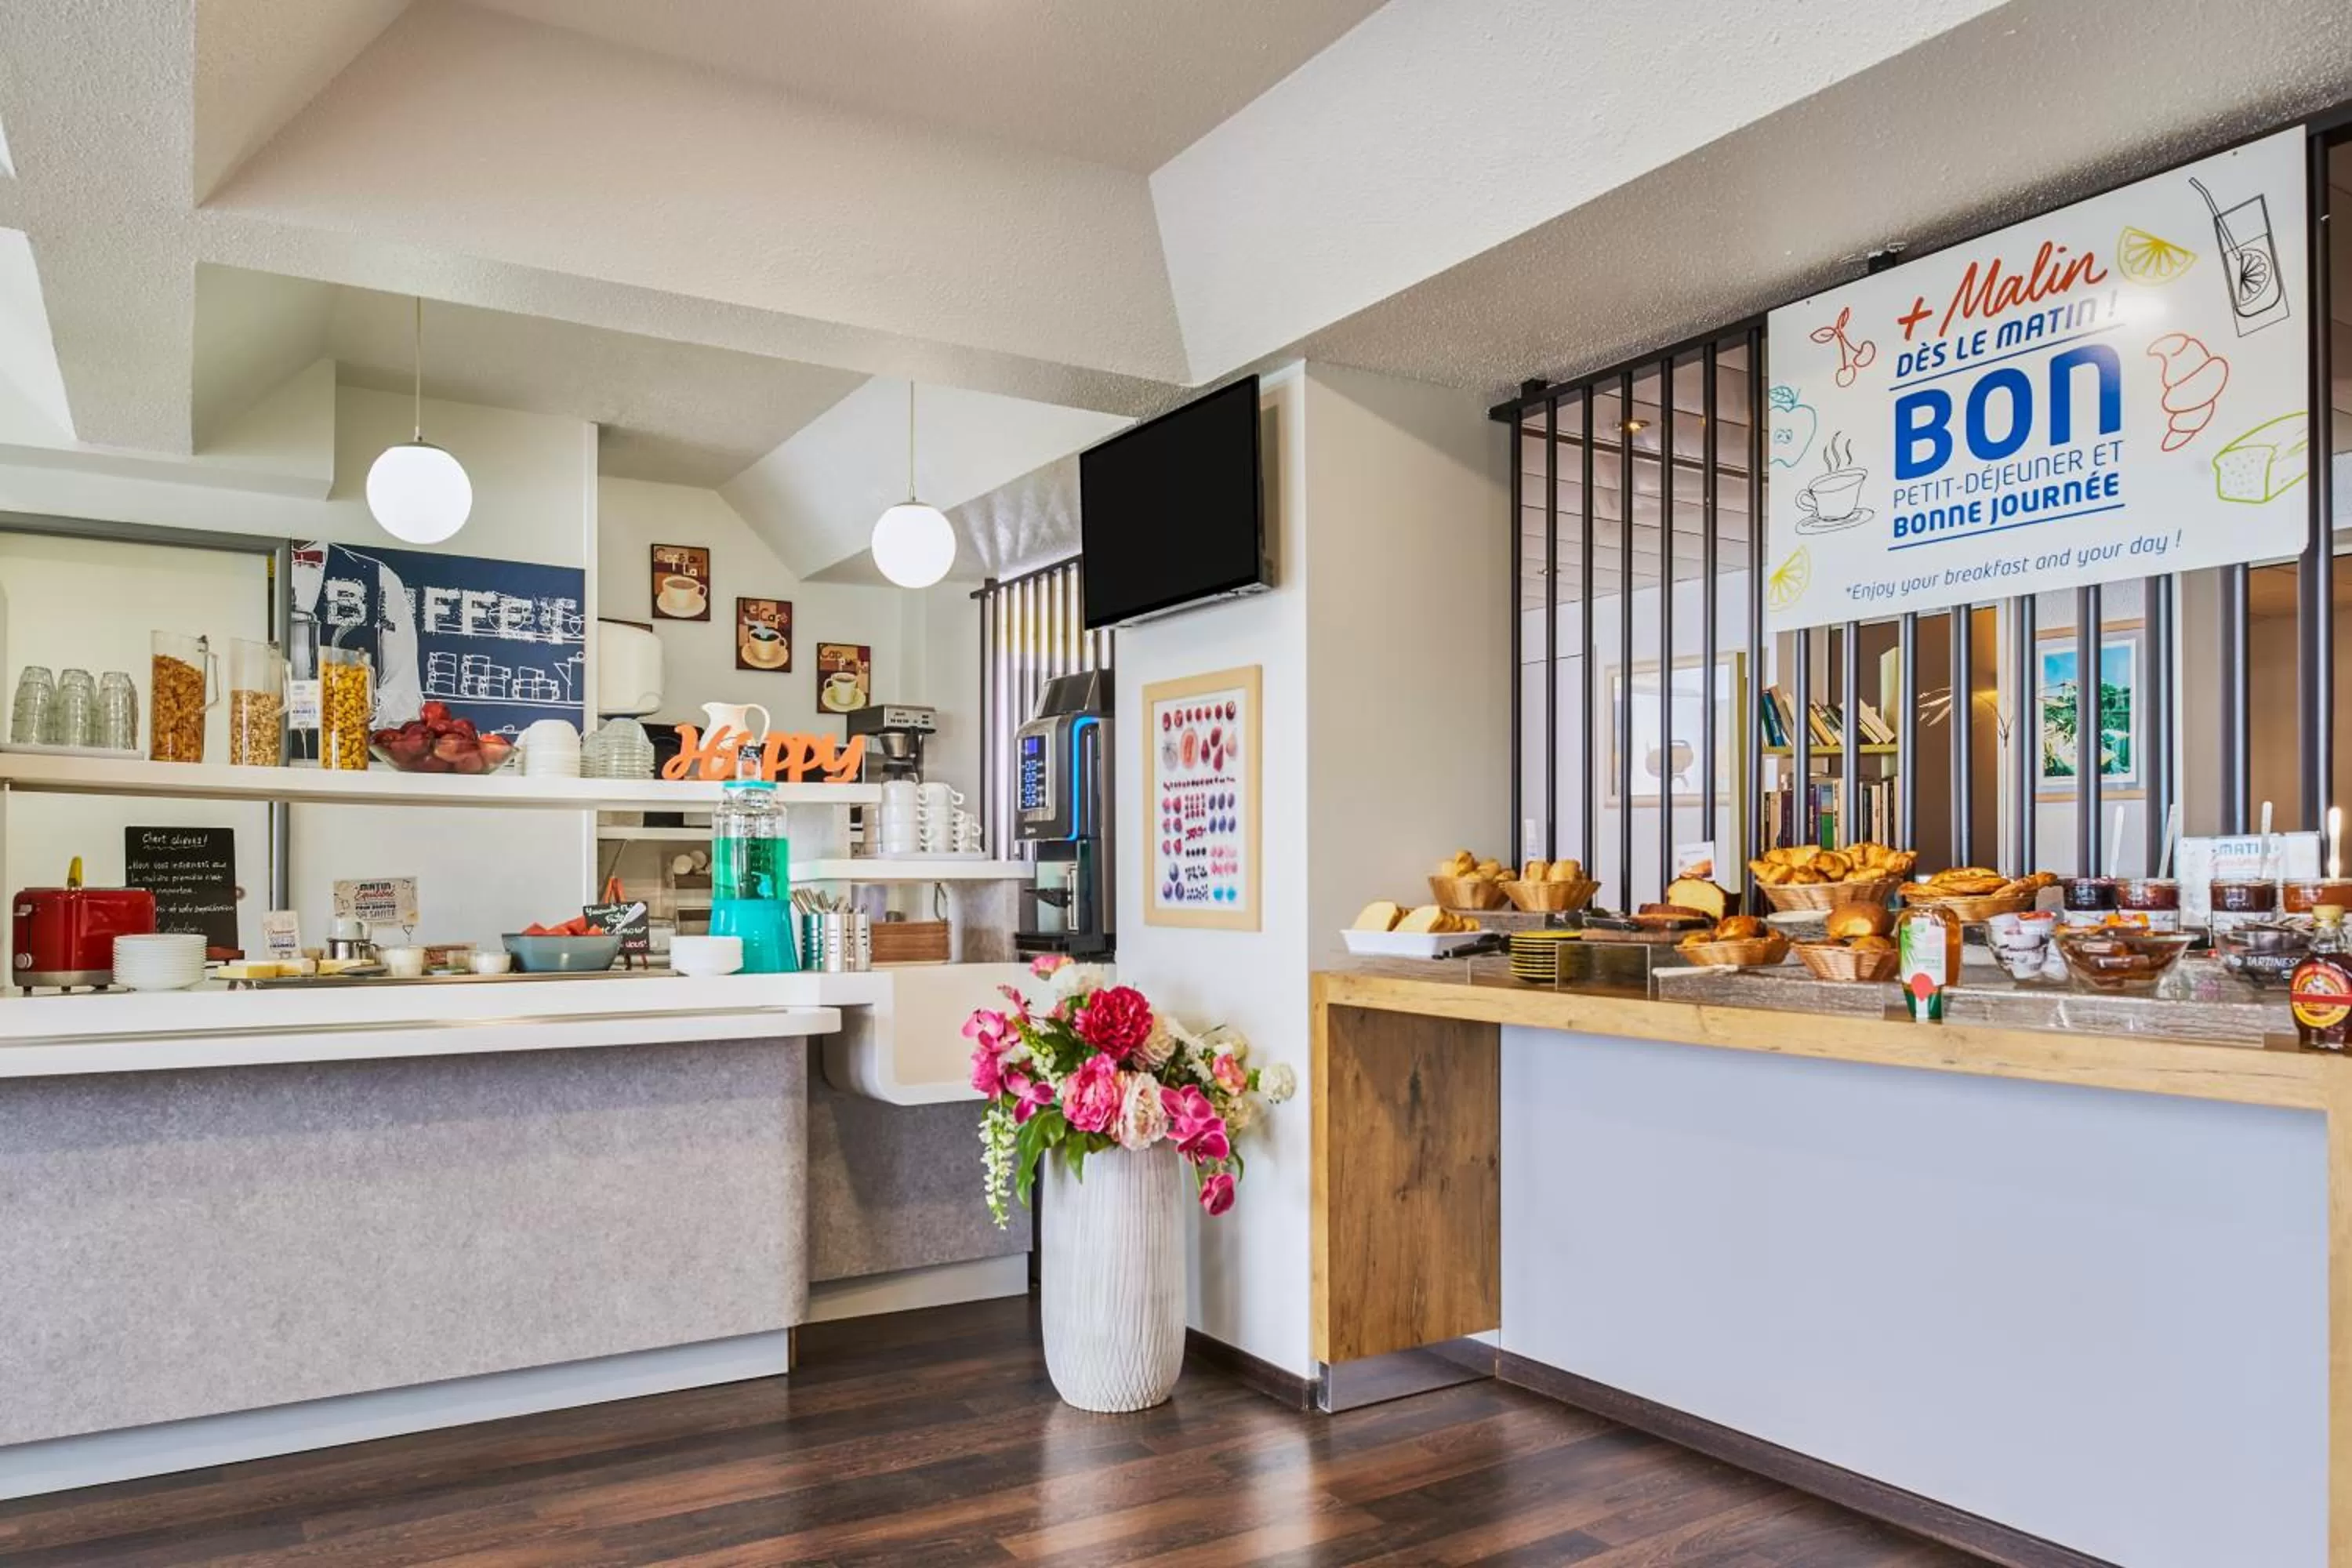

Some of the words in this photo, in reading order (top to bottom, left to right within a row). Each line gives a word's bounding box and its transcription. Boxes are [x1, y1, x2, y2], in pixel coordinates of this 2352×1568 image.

[1939, 241, 2108, 337] Malin
[1896, 342, 1947, 378] DÈS
[1957, 330, 1987, 360] LE
[1996, 296, 2098, 349] MATIN
[1895, 344, 2122, 481] BON
[1893, 449, 2084, 509] PETIT-DÉJEUNER
[2093, 440, 2125, 466] ET
[1893, 500, 1982, 538] BONNE
[1990, 471, 2120, 525] JOURNÉE
[1900, 575, 1940, 597] your
[1944, 556, 2030, 586] breakfast
[2036, 549, 2071, 571] and
[2077, 543, 2123, 567] your
[2130, 535, 2169, 559] day
[324, 577, 578, 644] BFFET
[662, 721, 866, 782] Happy
